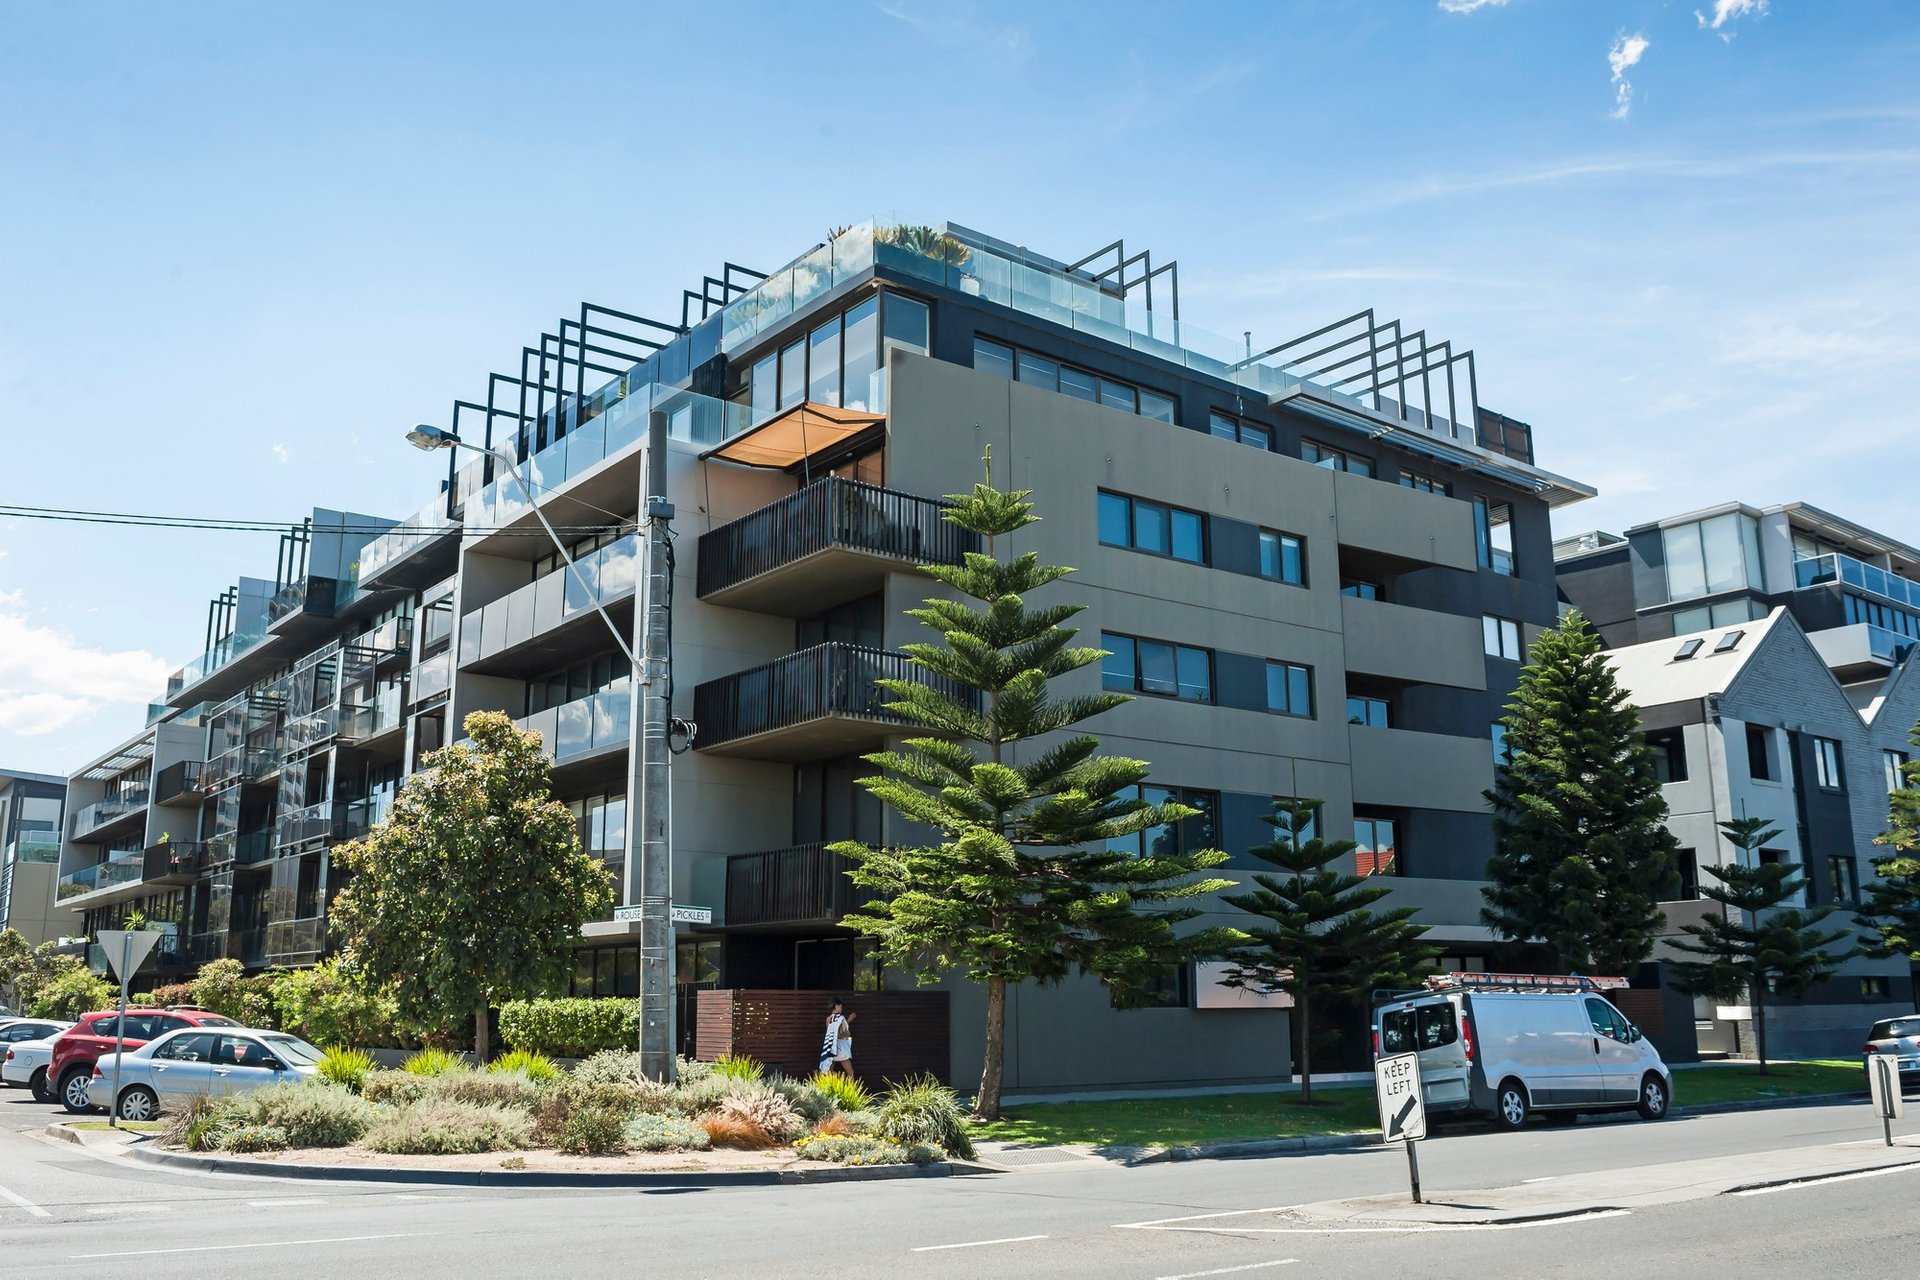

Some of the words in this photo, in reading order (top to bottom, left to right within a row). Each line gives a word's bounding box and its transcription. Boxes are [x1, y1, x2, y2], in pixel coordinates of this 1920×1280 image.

[621, 910, 640, 920] ROUSE
[676, 910, 704, 921] PICKLES
[1384, 1062, 1410, 1079] KEEP
[1387, 1080, 1410, 1096] LEFT
